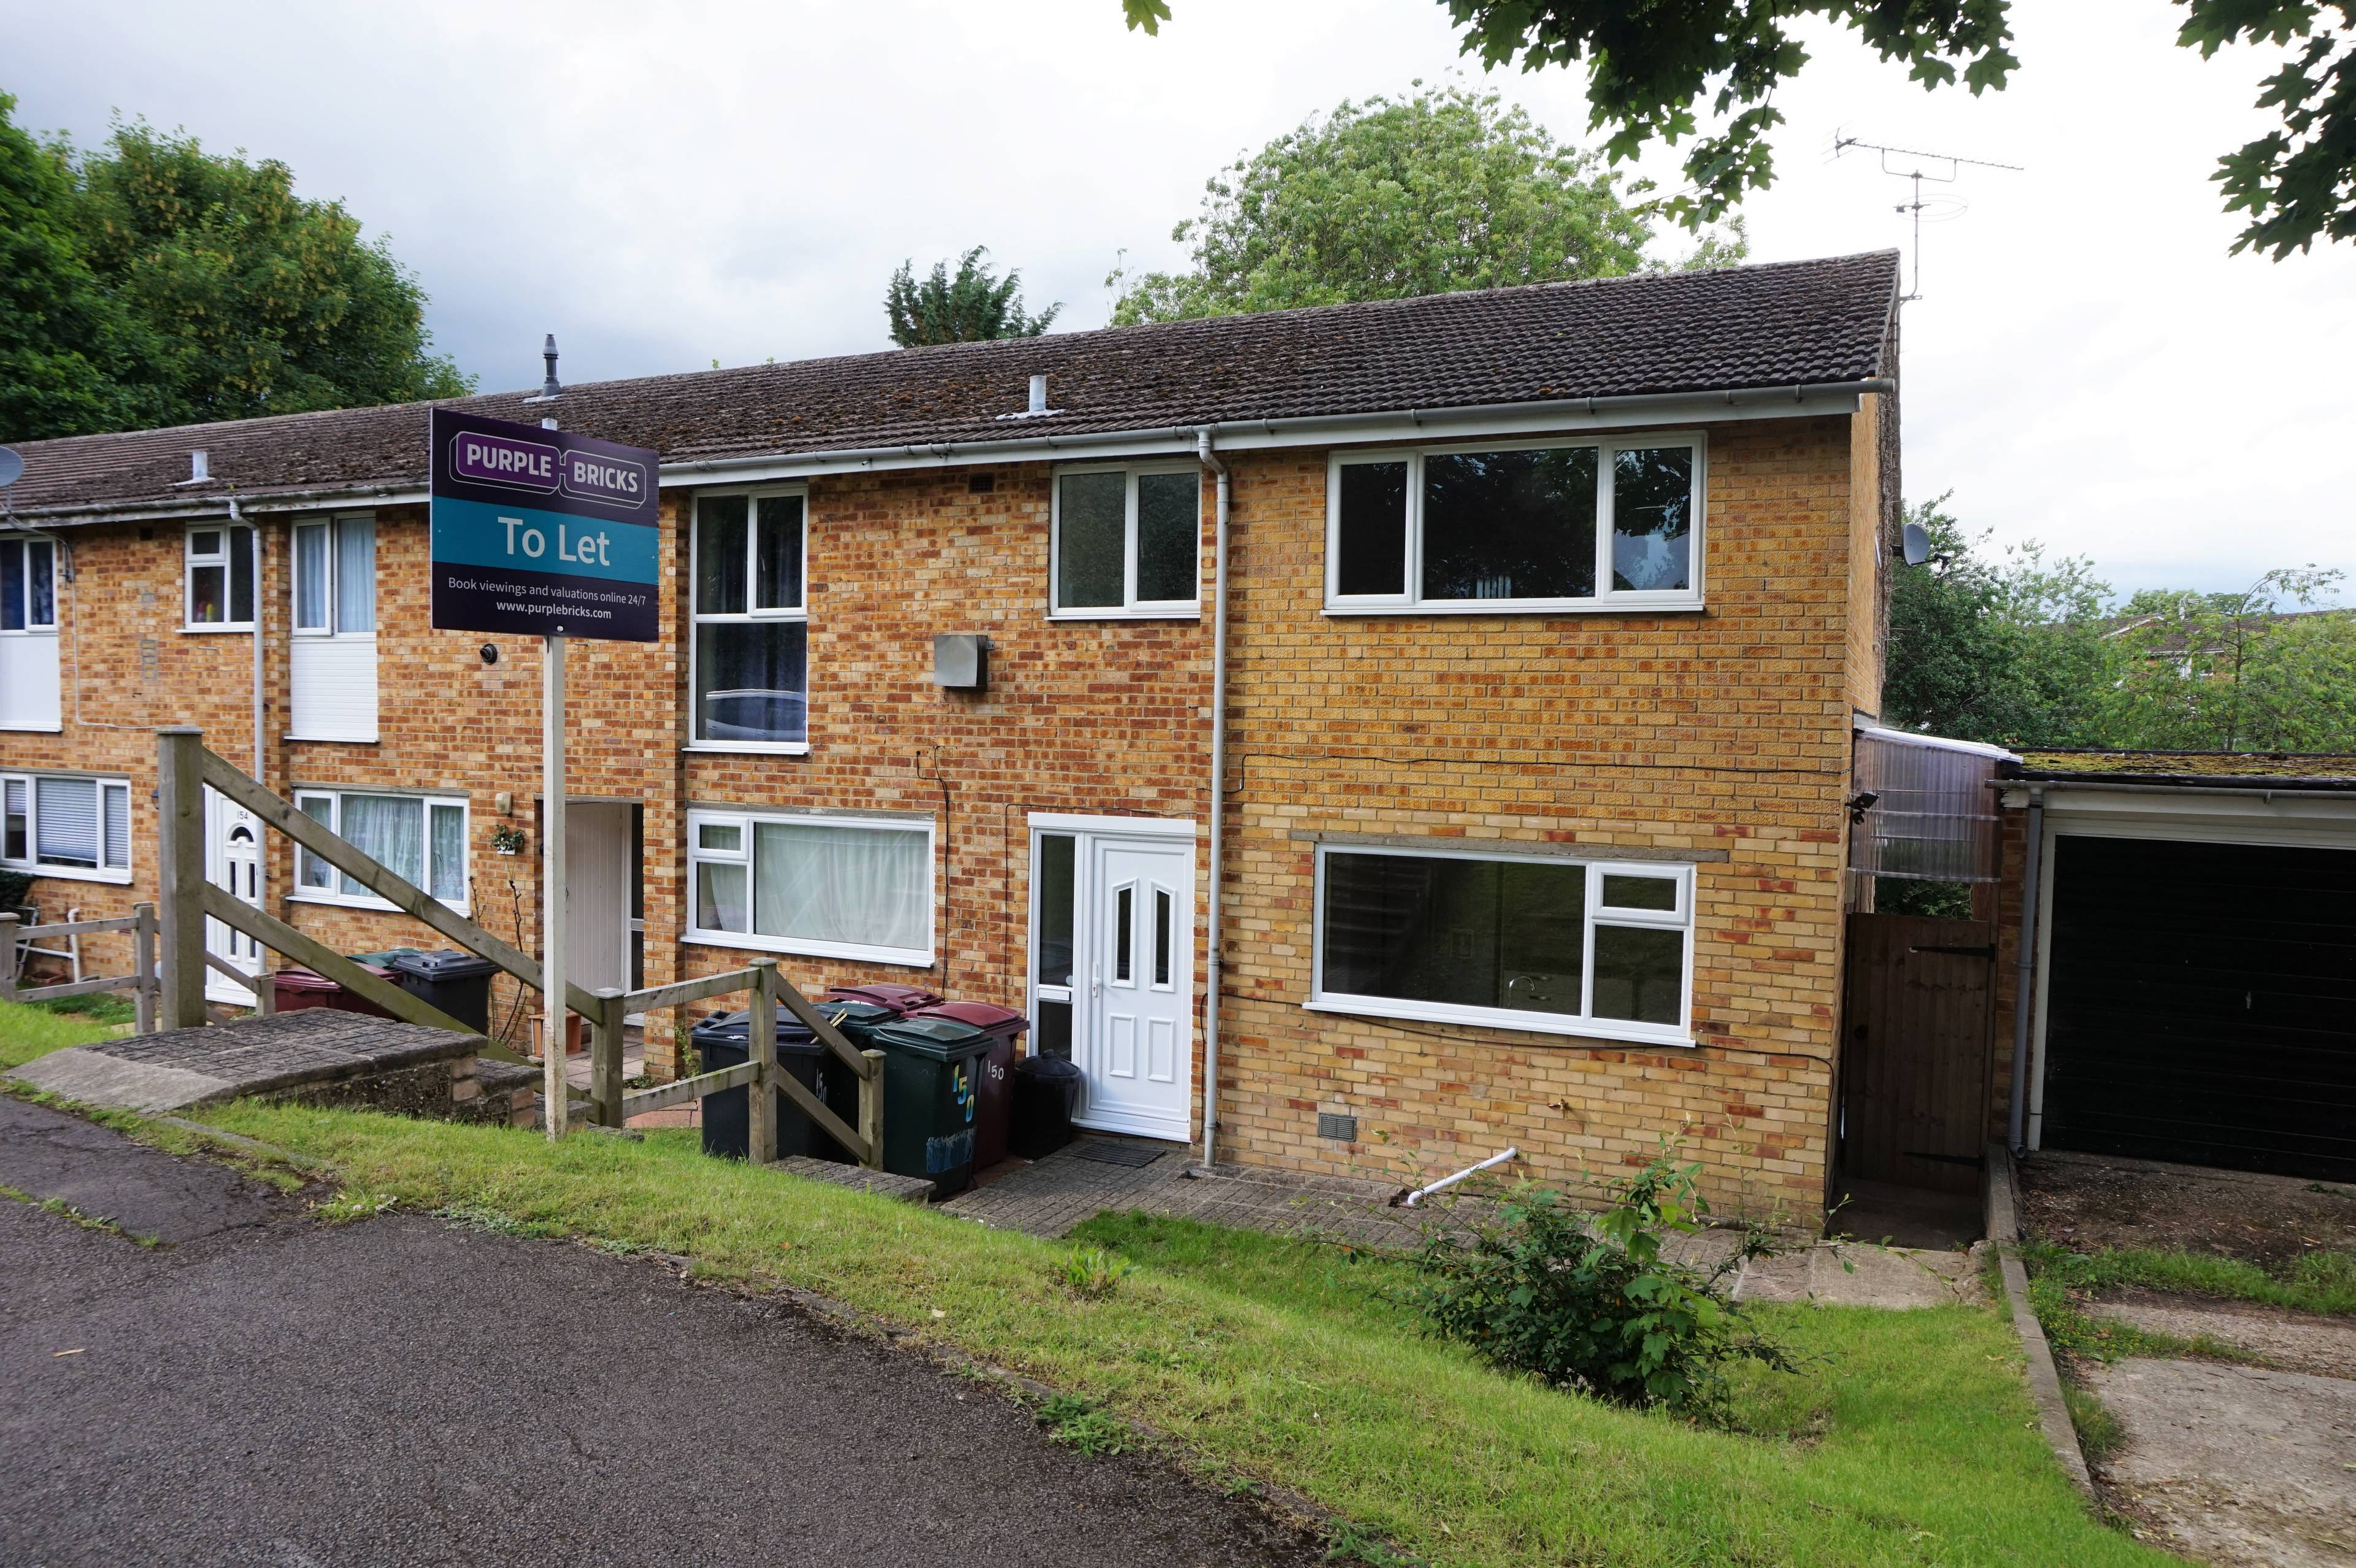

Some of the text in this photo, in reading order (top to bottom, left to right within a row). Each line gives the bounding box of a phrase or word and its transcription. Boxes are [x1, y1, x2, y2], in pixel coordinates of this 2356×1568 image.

[467, 444, 638, 493] PURPLE BRICKS
[498, 516, 610, 566] To Let
[448, 577, 646, 607] Book viewings and valuations online 24/7
[496, 601, 611, 619] www.purplebricks.com
[237, 811, 248, 820] 154
[987, 1059, 1004, 1080] 150
[953, 1065, 974, 1123] 150
